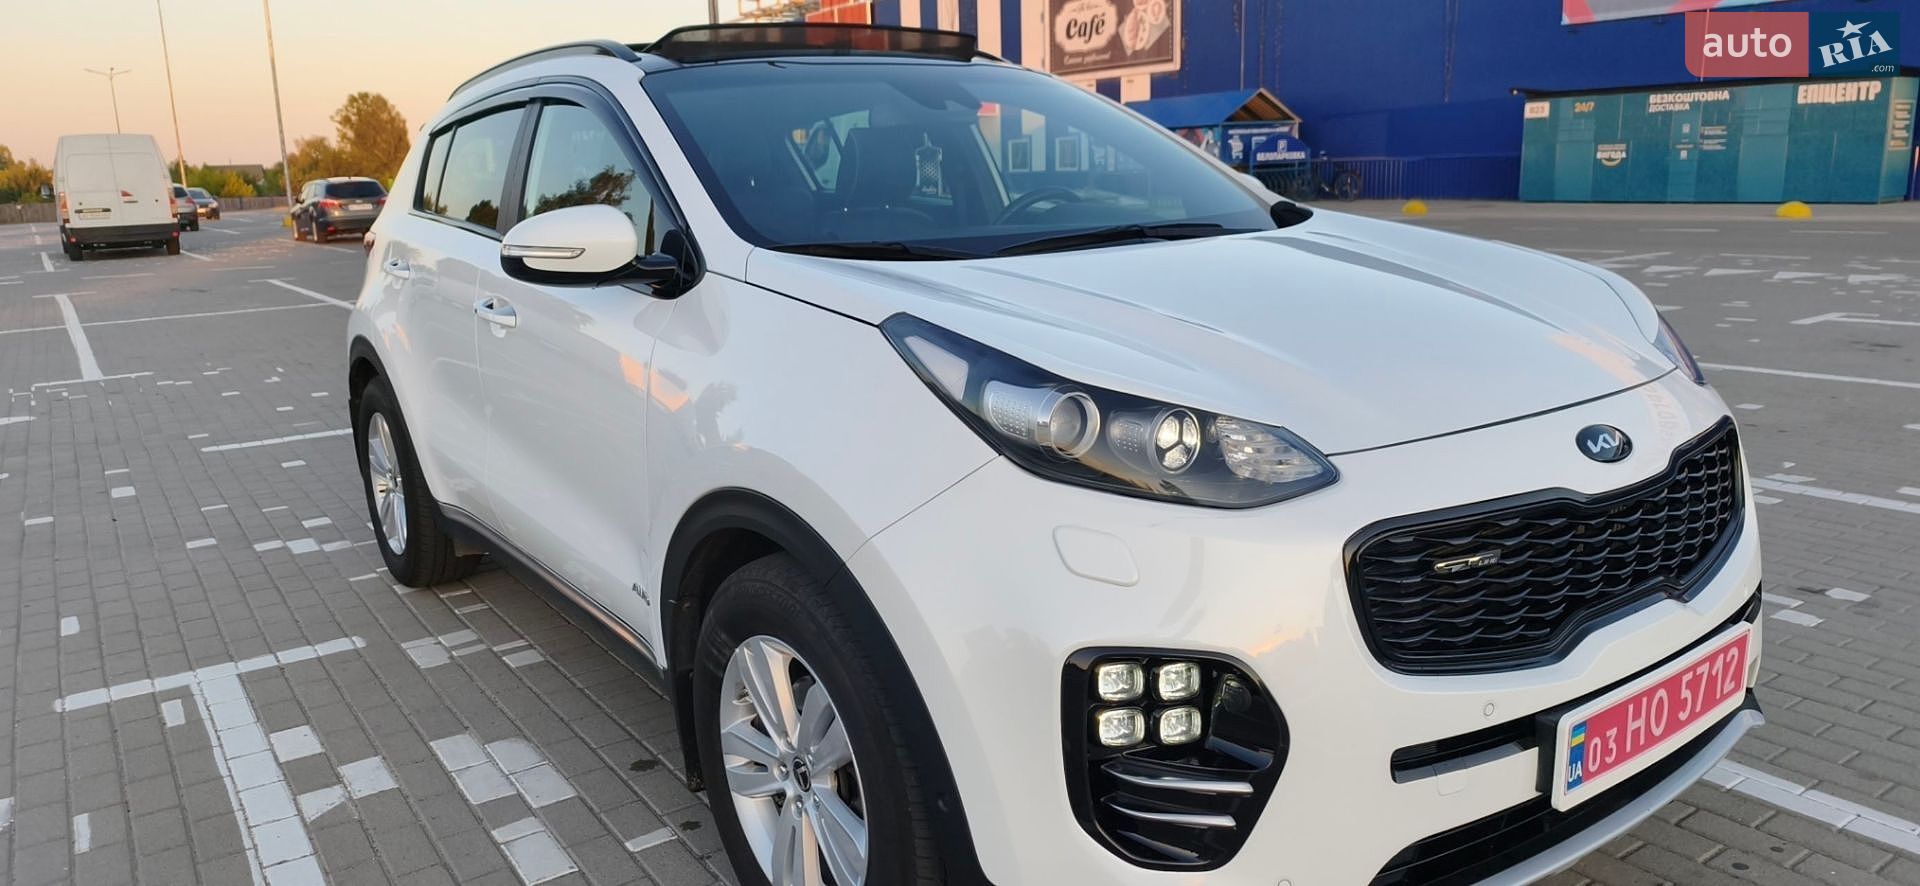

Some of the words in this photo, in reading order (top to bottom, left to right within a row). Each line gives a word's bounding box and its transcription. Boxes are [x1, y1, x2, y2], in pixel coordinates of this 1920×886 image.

[1066, 12, 1106, 44] Café
[1649, 90, 1730, 104] БЕЗКОШТОВНА
[1649, 102, 1691, 113] ДОСТАВКА
[1588, 727, 1618, 773] 03
[1678, 646, 1739, 721] 5712
[1568, 763, 1582, 782] UA
